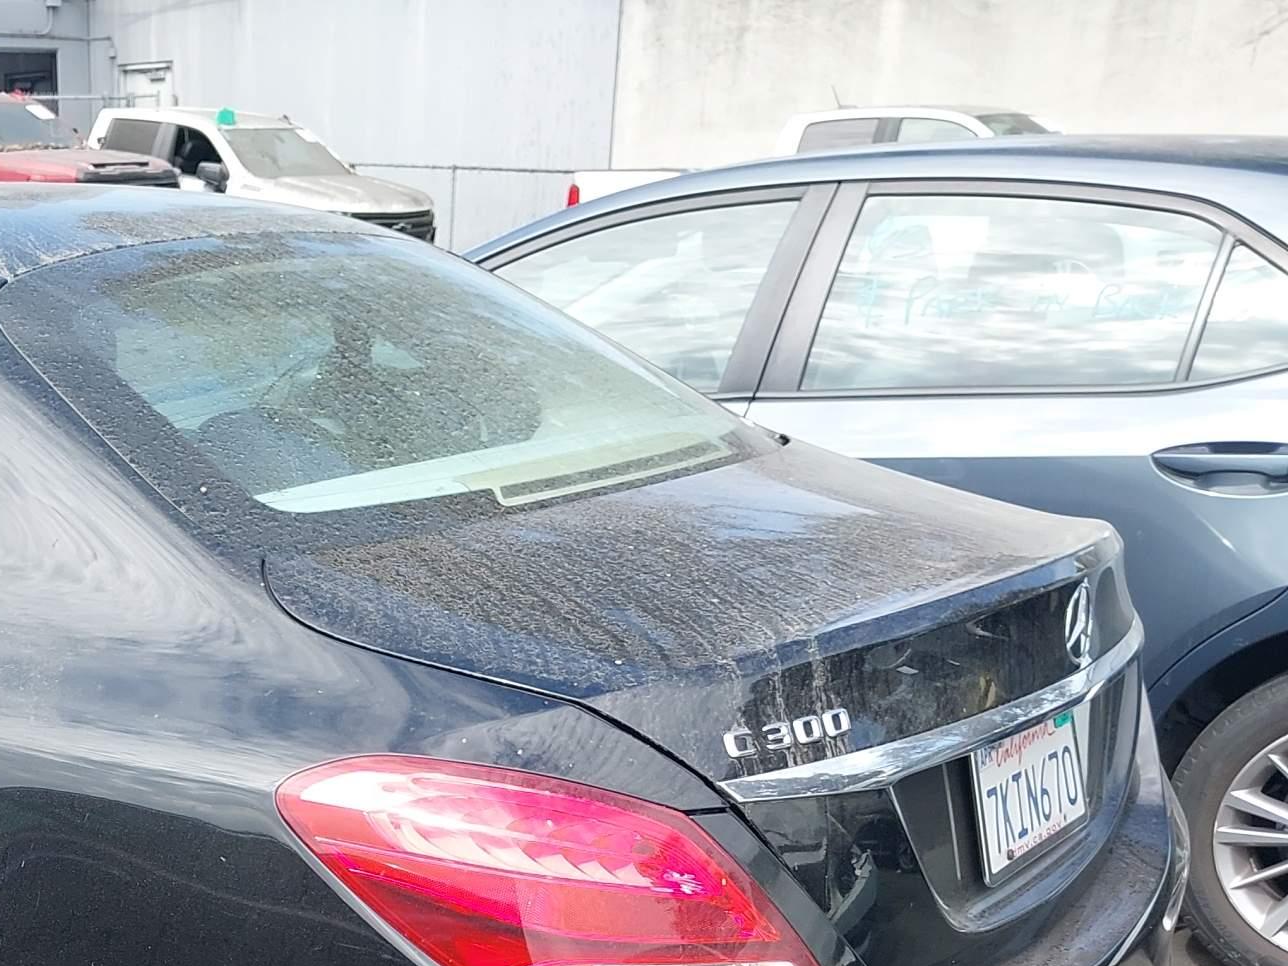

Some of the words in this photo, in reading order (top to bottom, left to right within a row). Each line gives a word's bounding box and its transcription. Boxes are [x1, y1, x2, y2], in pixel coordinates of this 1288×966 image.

[723, 730, 758, 758] C
[762, 708, 851, 750] 300
[986, 745, 1079, 855] 7KIN670
